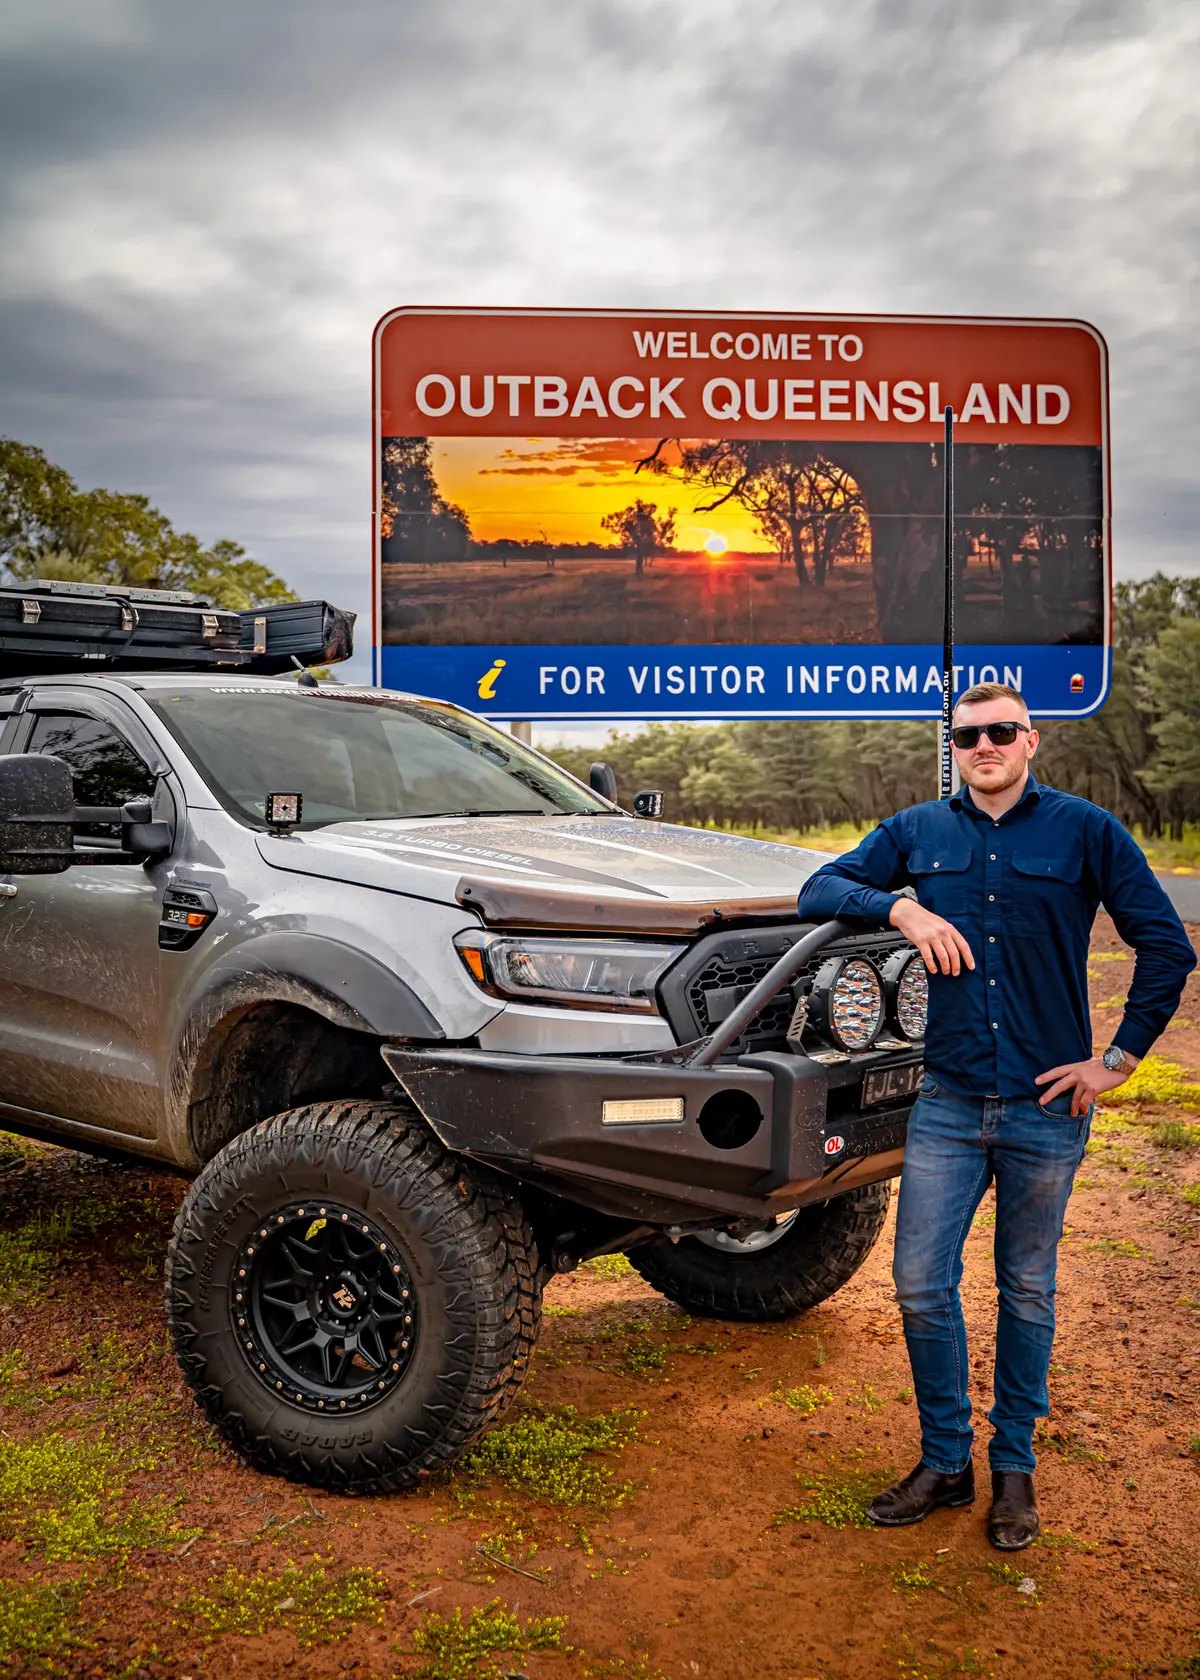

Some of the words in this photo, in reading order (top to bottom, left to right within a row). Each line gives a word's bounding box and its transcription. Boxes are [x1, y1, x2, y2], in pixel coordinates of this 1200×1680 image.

[633, 331, 812, 360] WELCOME
[818, 334, 864, 362] TO
[415, 374, 686, 418] OUTBACK
[702, 377, 1071, 425] QUEENSLAND
[539, 665, 606, 695] FOR
[628, 665, 766, 695] VISITOR
[786, 665, 1023, 694] INFORMATION
[362, 829, 394, 840] 3.2
[395, 834, 463, 850] TURBO
[463, 846, 533, 866] DIESEL
